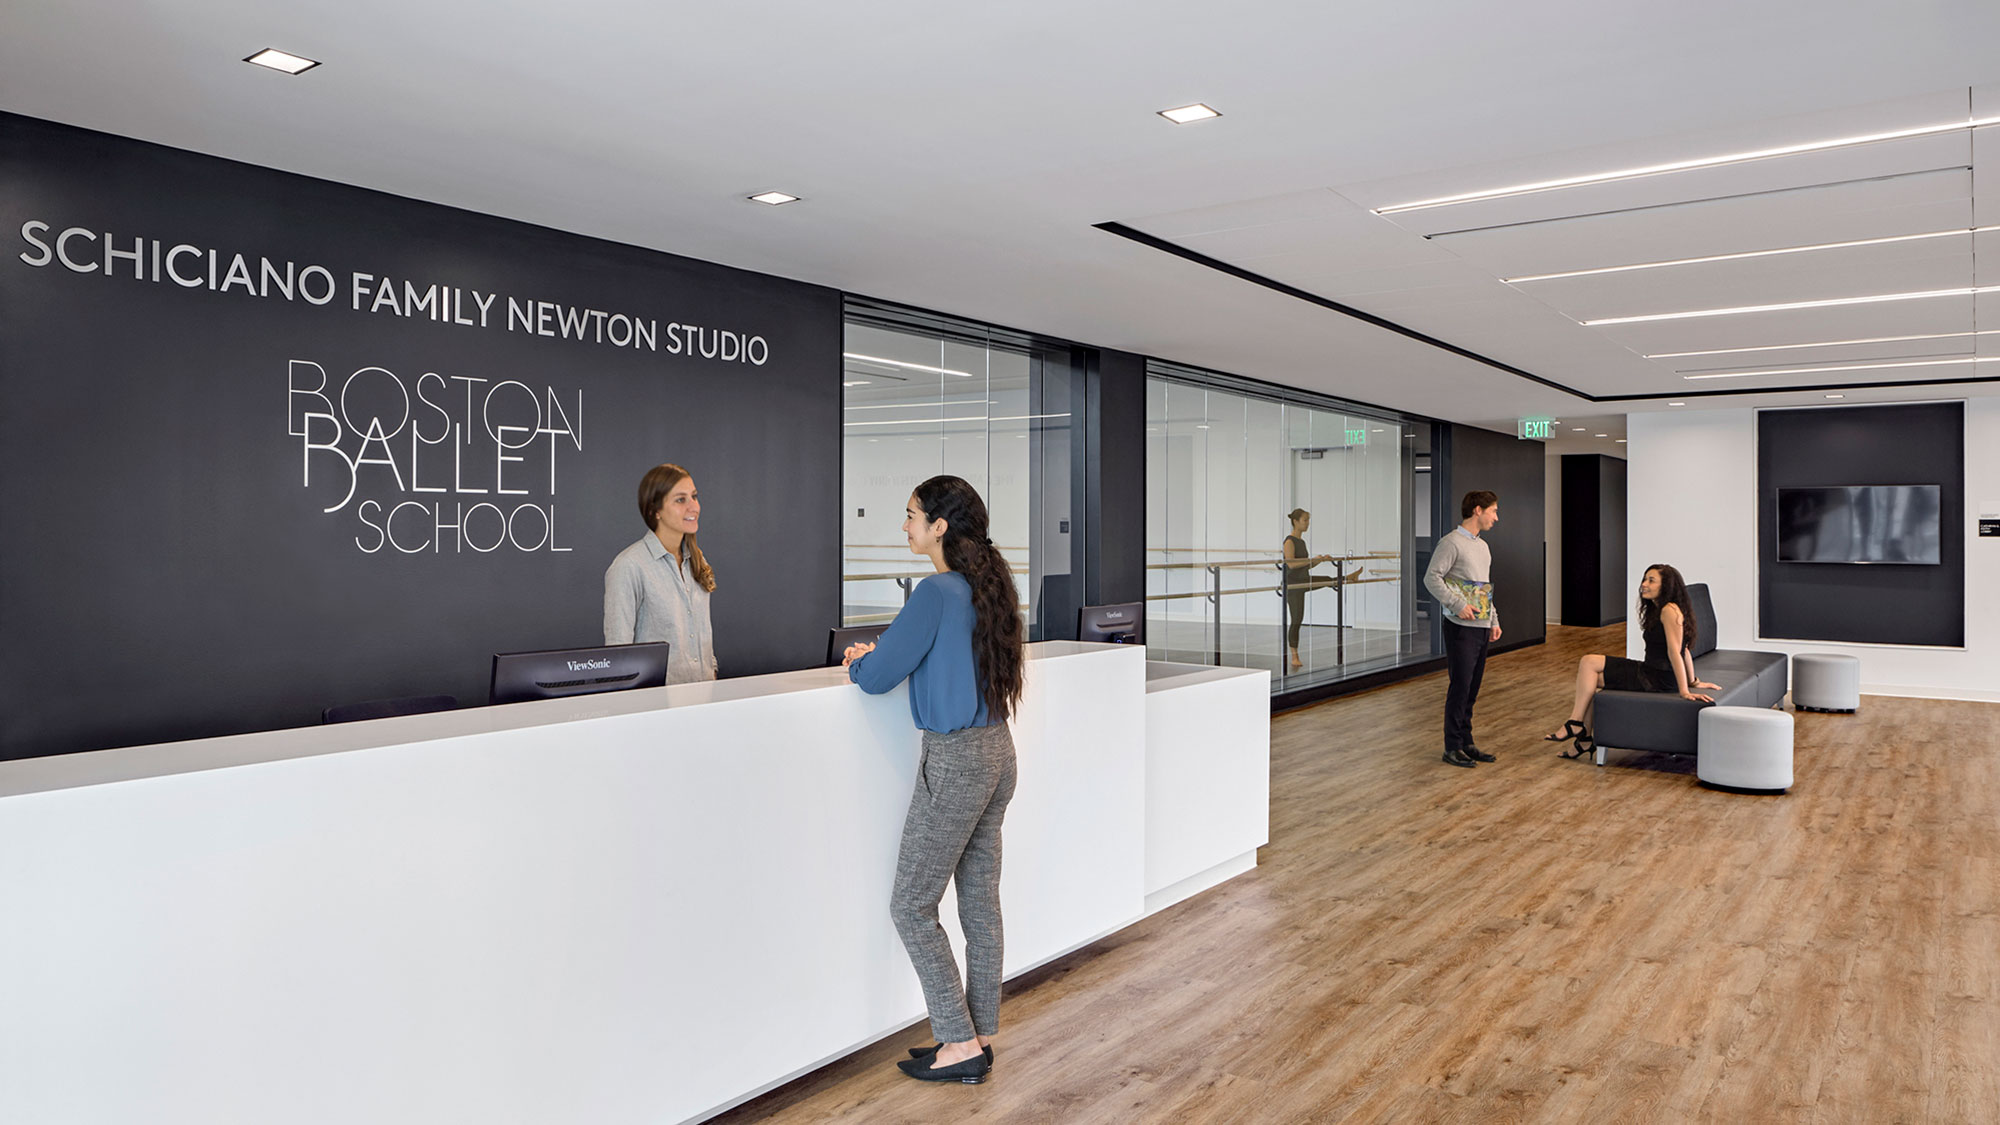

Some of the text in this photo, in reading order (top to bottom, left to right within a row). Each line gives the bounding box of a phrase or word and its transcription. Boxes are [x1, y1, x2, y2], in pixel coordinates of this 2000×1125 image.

[19, 220, 769, 366] SCHICIANO FAMILY NEWTON STUDIO
[288, 359, 583, 452] BOSTON
[1525, 420, 1550, 438] EXIT
[303, 411, 571, 514] BALLET
[355, 499, 574, 554] SCHOOL
[567, 658, 611, 671] ViewSonic
